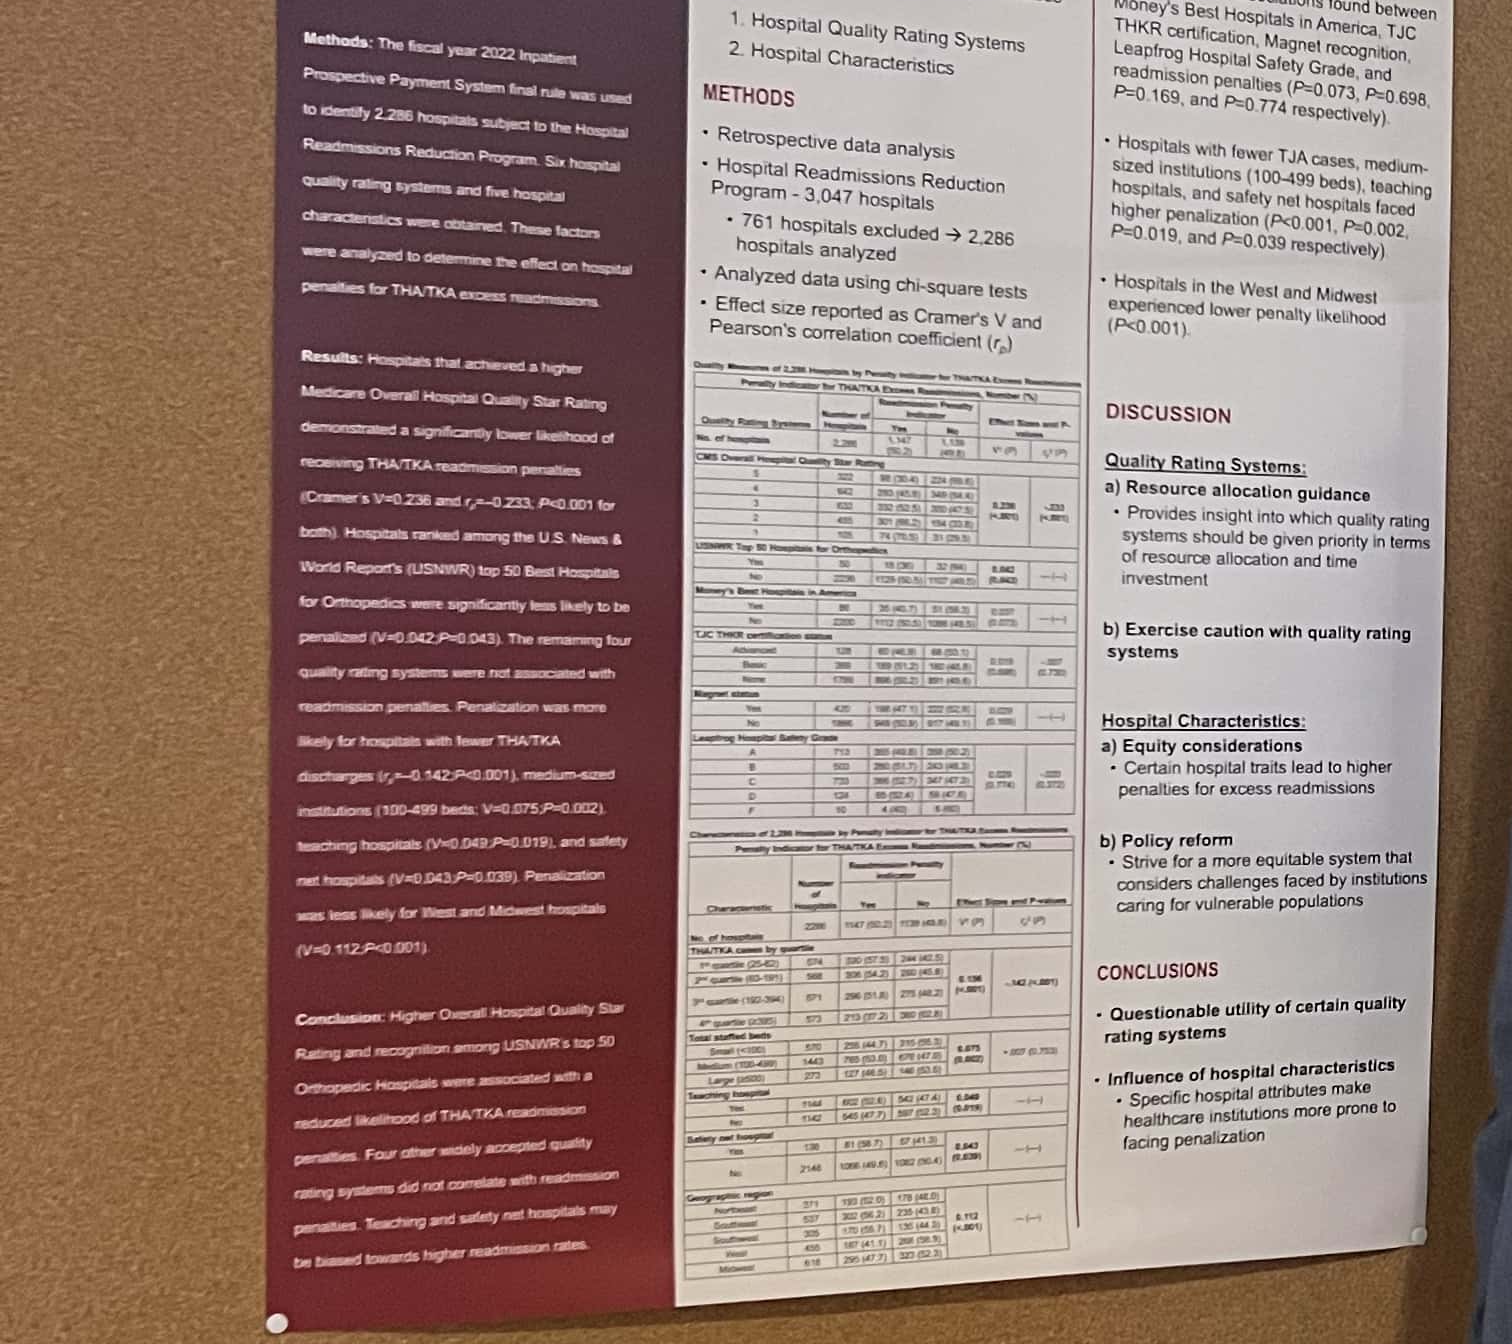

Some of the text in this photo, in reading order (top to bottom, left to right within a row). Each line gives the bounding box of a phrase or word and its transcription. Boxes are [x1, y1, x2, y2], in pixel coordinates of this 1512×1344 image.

[751, 11, 822, 34] Hospital
[827, 18, 888, 43] Quality
[893, 24, 948, 49] Rating
[953, 30, 1025, 53] Systems
[302, 30, 373, 48] Methods:
[376, 36, 404, 51] The
[407, 39, 444, 54] fiscal
[446, 45, 478, 58] year
[480, 45, 516, 61] 2022
[750, 41, 821, 64] Hospital
[826, 49, 954, 76] Characteristics
[702, 82, 794, 108] METHODS
[717, 125, 955, 161] Retrospective data analysis
[716, 156, 1005, 193] Hospital Readmissions Reduction
[1113, 272, 1377, 305] Hospitals in the West and Midwest
[1105, 402, 1231, 424] DISCUSSION
[1104, 451, 1306, 477] Quality Rating Systems:
[1104, 478, 1370, 503] a) Resource allocation guidance
[1102, 621, 1411, 643] b) Exercise caution with quality rating
[1106, 644, 1178, 662] systems
[1101, 712, 1305, 732] Hospital Characteristics:
[1100, 737, 1302, 756] a) Equity considerations
[1099, 832, 1233, 851] b) Policy reform
[1096, 961, 1218, 981] CONCLUSIONS
[1109, 995, 1407, 1021] Questionable utility of certain quality
[1104, 1026, 1226, 1045] rating systems
[1107, 1058, 1395, 1086] Influence of hospital characteristics
